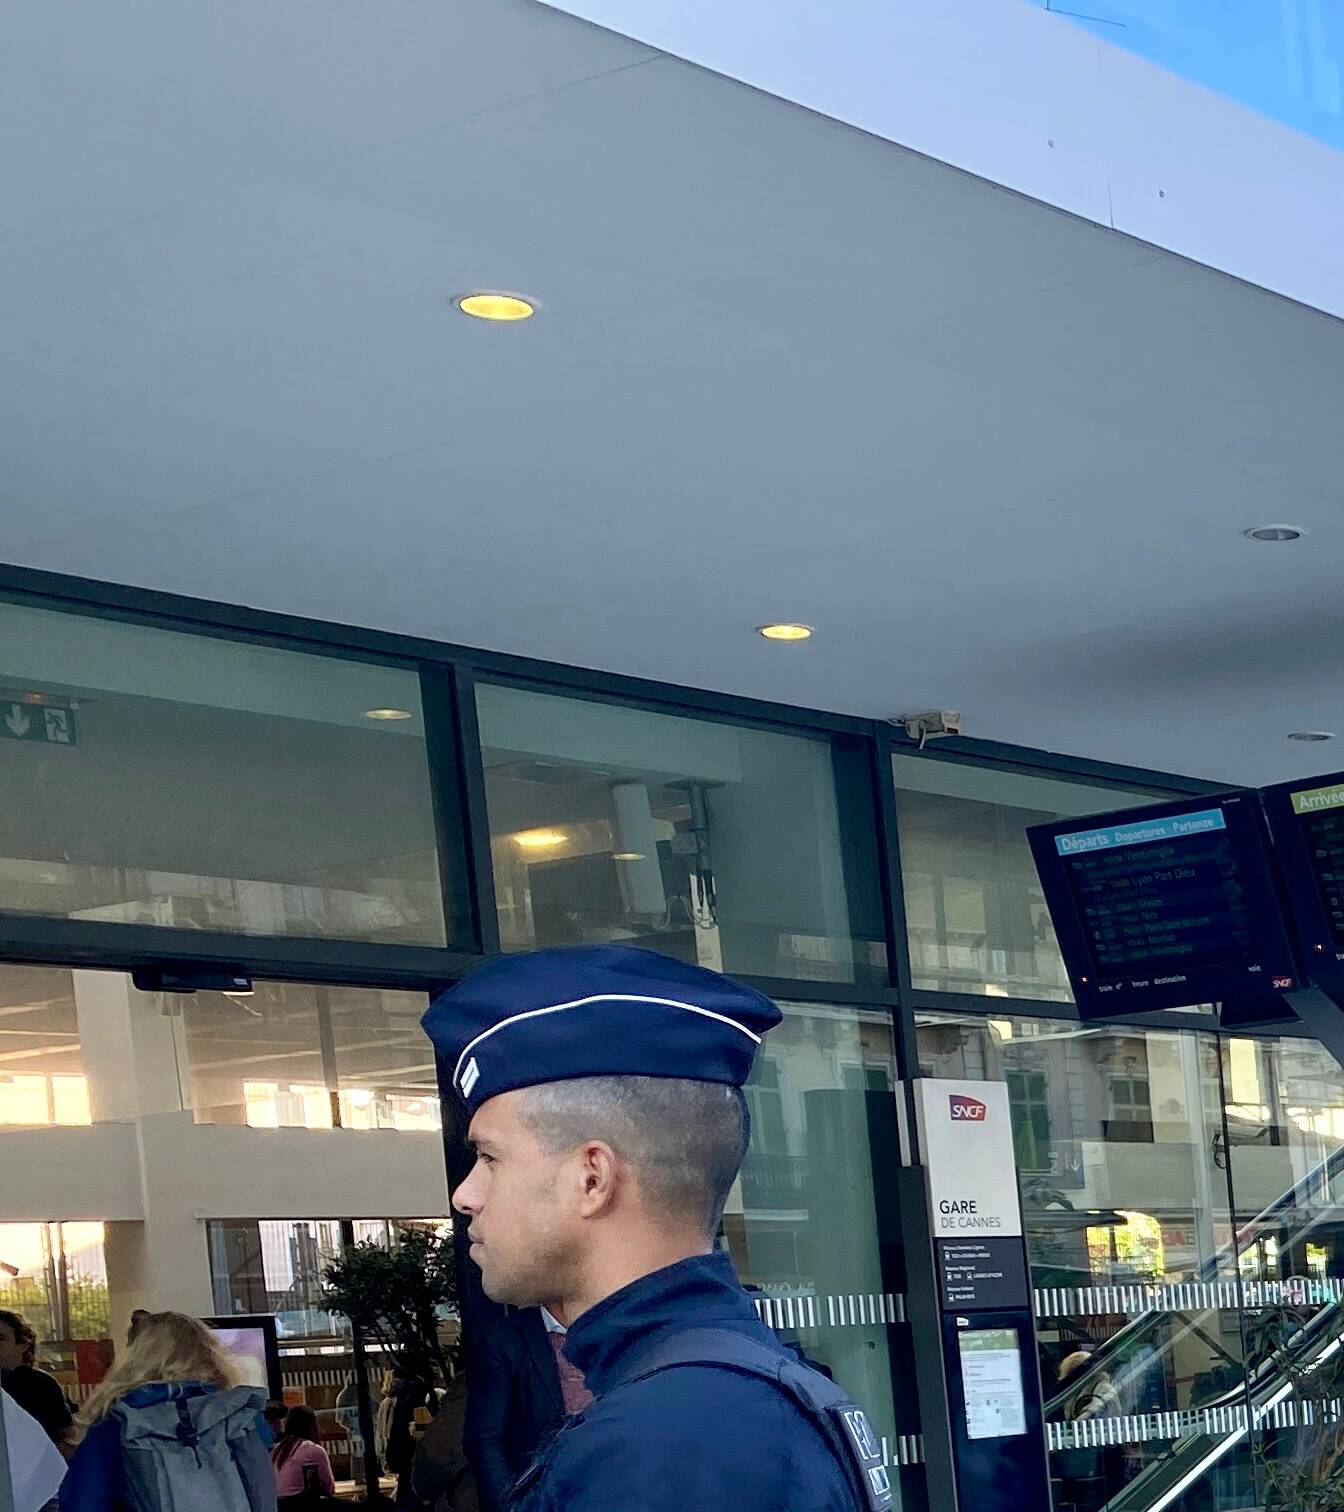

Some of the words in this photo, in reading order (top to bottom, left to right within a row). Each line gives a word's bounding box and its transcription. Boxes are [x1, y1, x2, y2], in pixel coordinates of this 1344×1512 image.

[1061, 833, 1109, 851] Départs
[951, 1104, 985, 1120] SNCF
[939, 1199, 978, 1215] GARE
[941, 1216, 956, 1229] DE
[958, 1215, 1001, 1228] CANNES
